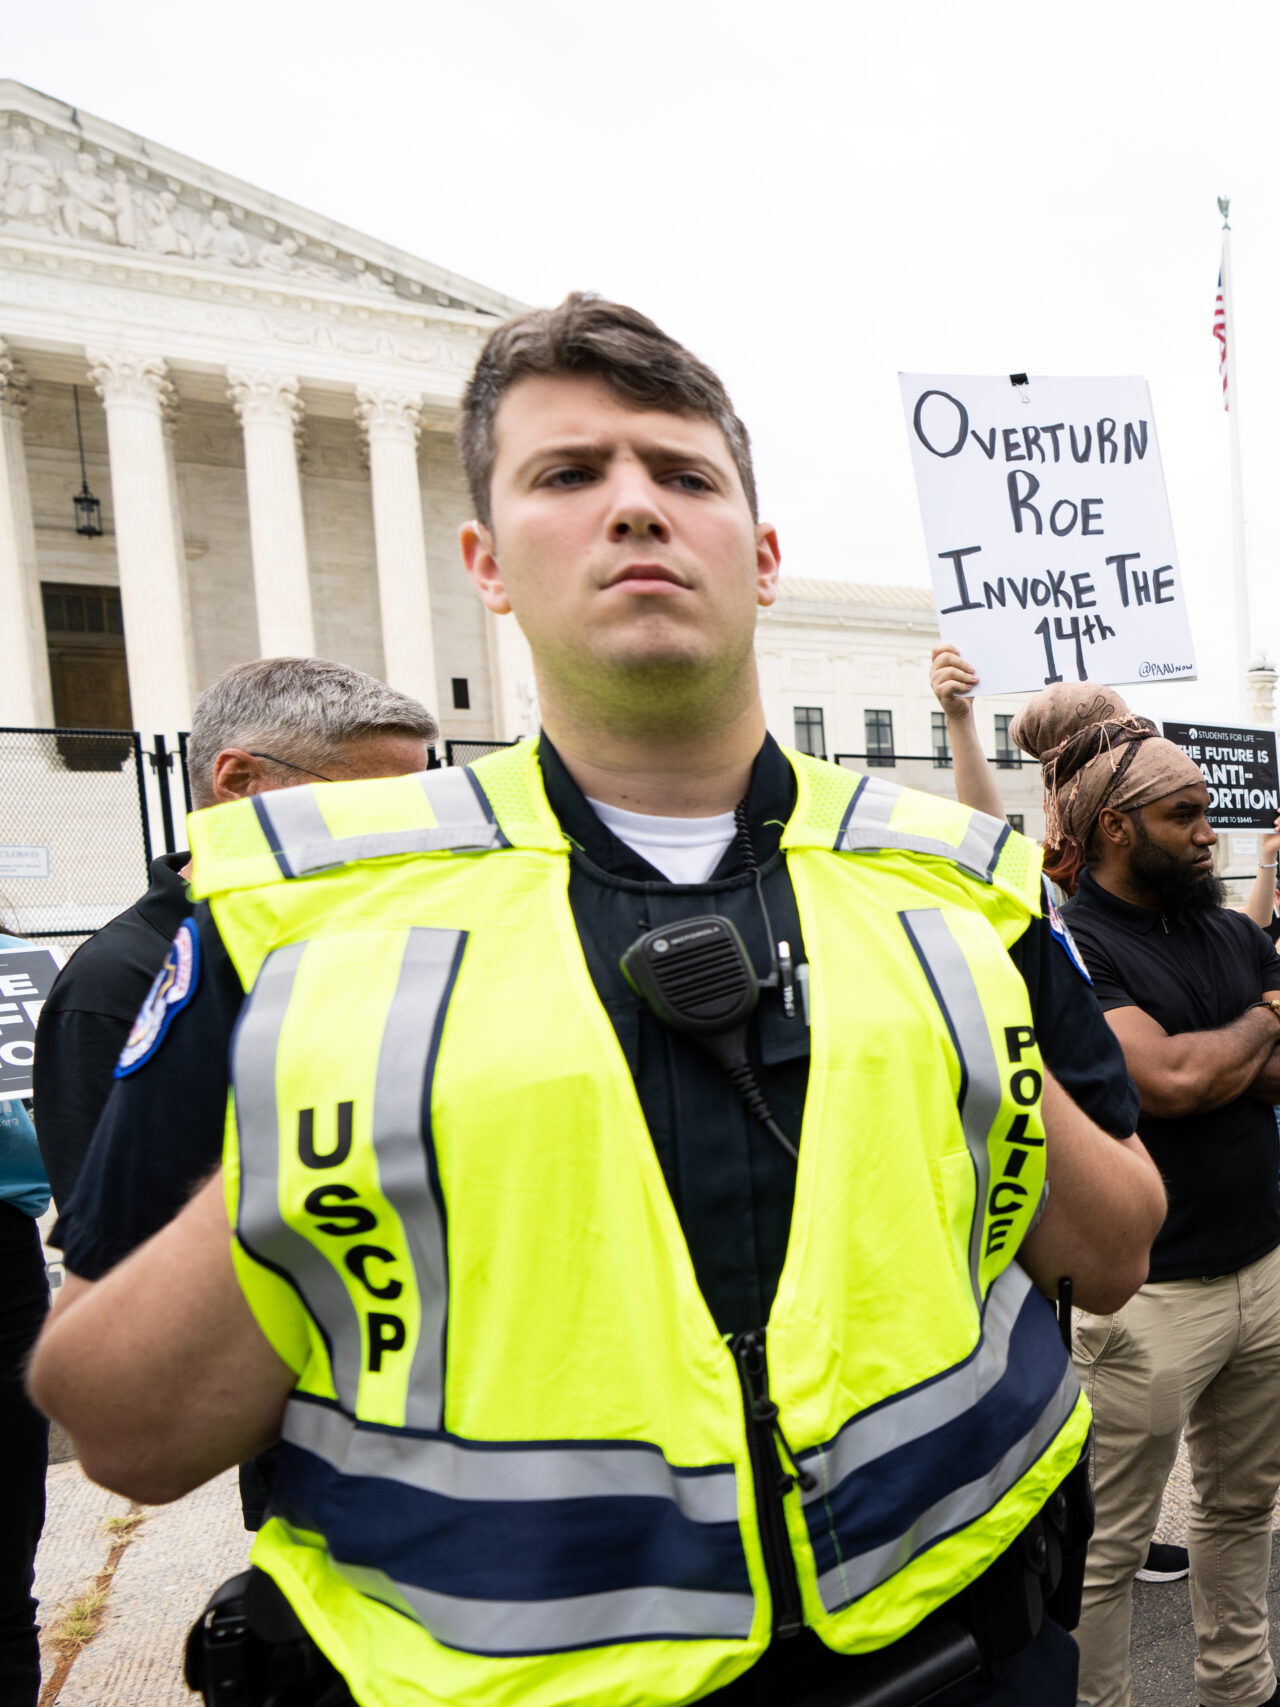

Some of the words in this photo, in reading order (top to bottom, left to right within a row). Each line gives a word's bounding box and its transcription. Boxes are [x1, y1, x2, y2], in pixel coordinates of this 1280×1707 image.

[913, 389, 1148, 464] OVERTURN
[1008, 469, 1105, 536] ROE
[938, 545, 1097, 614] INVOKE
[1105, 552, 1175, 608] THE
[1034, 615, 1116, 686] 14th
[1198, 731, 1229, 741] STUDENTS
[1230, 733, 1243, 742] FOR
[1243, 734, 1255, 743] LIFE
[1205, 746, 1255, 763] FUTURE
[1257, 750, 1269, 764] IS
[1199, 763, 1254, 786] ANTI-
[1207, 787, 1279, 810] ORTION
[1218, 816, 1229, 824] LIFE
[985, 1025, 1045, 1259] POLICE
[297, 1100, 406, 1373] USCP
